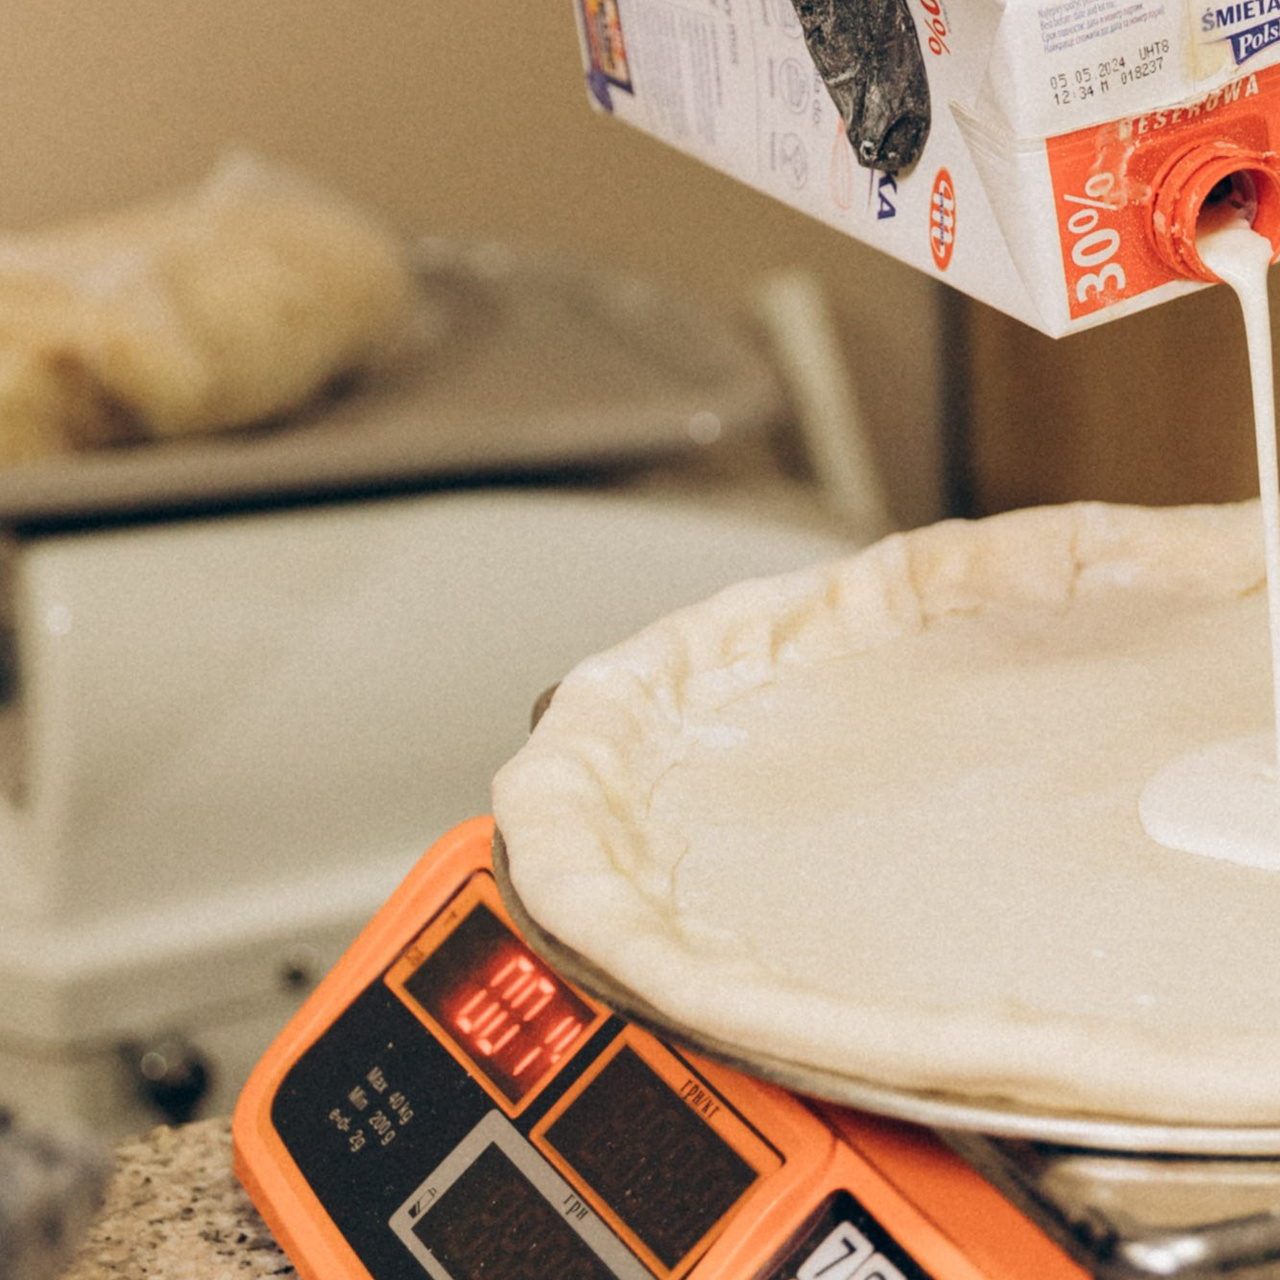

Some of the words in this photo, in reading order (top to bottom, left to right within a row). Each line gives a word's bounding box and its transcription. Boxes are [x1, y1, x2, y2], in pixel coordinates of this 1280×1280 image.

[1050, 57, 1126, 90] 05.05.2024
[1139, 39, 1170, 61] UHT8
[1053, 85, 1094, 105] 12:34
[1121, 57, 1164, 85] 018237
[1063, 172, 1126, 304] 30%
[348, 1085, 369, 1111] Min
[365, 1066, 388, 1094] Max
[814, 1237, 858, 1279] 7
